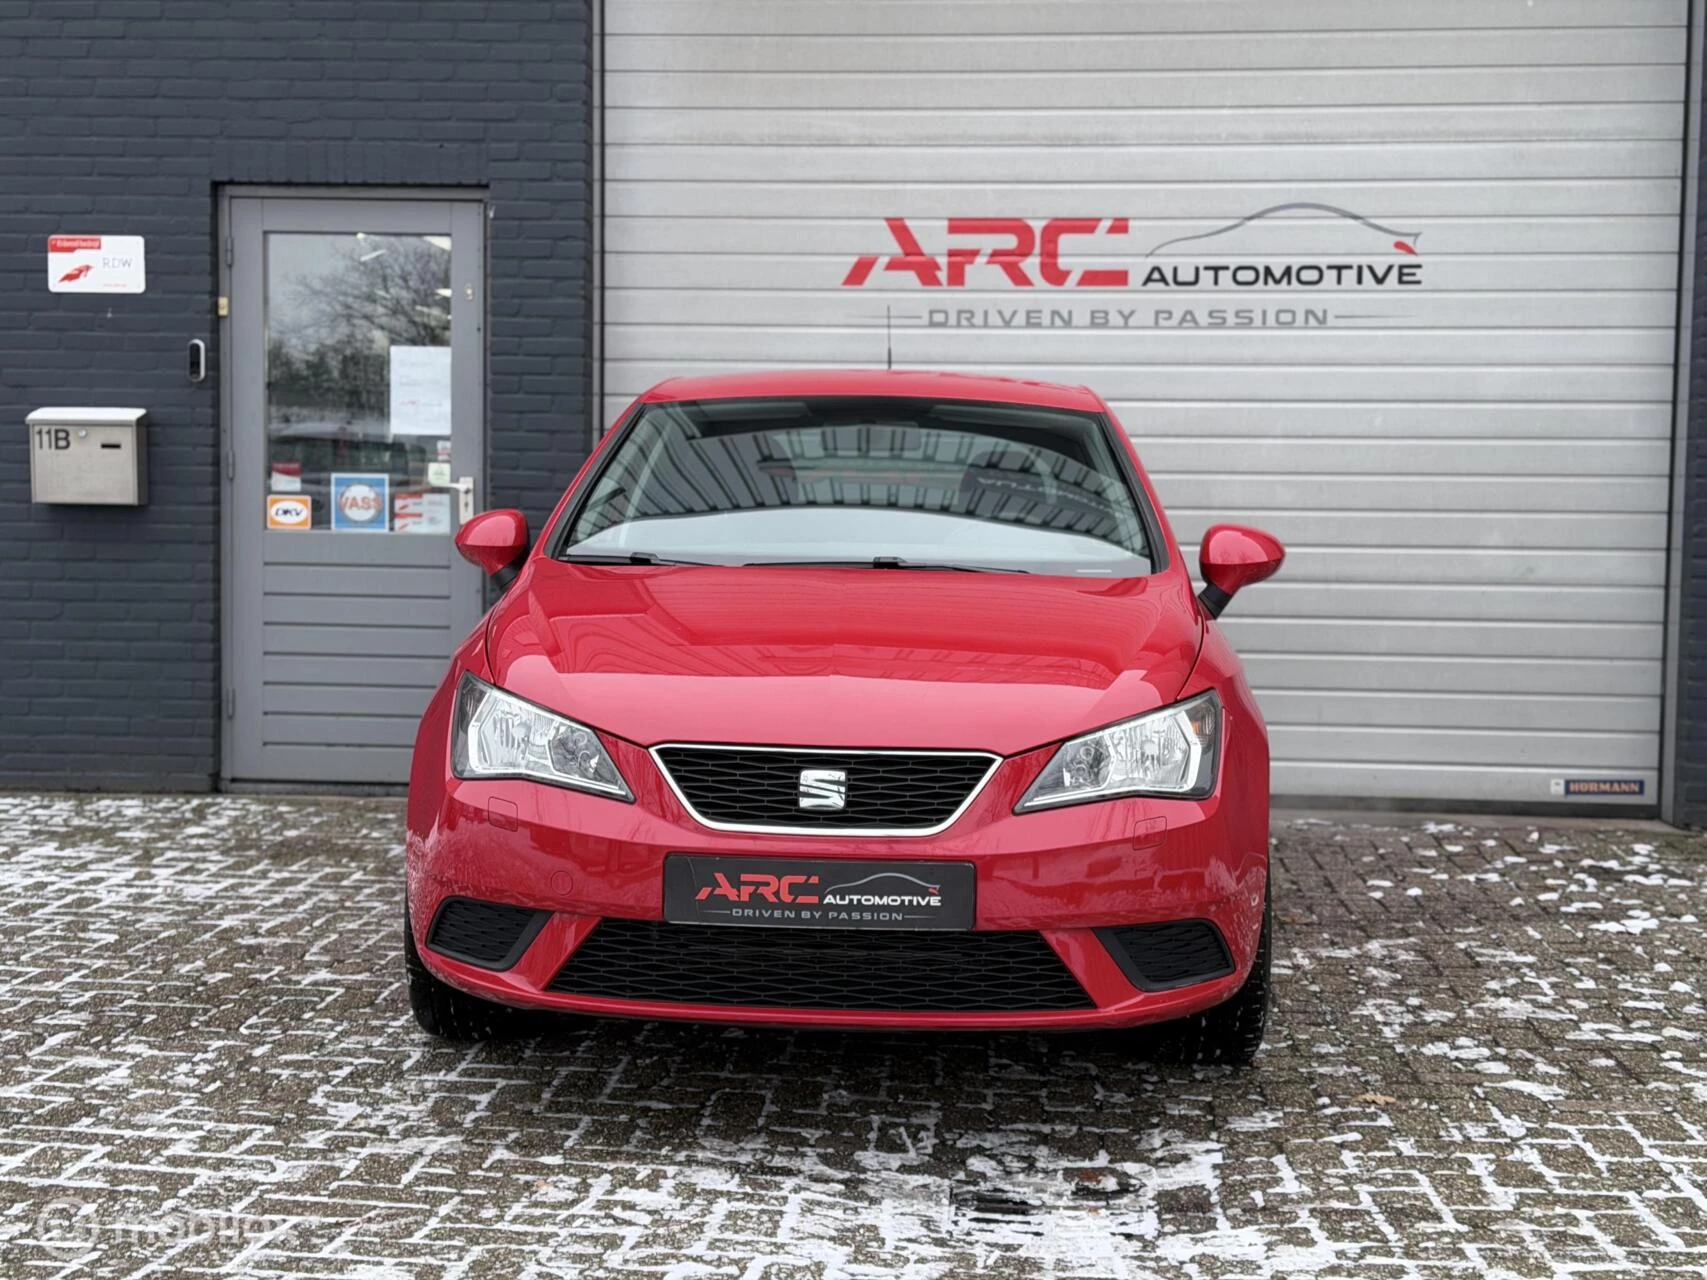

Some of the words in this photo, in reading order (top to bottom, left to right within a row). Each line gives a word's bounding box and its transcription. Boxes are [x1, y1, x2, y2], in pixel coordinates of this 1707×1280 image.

[102, 257, 133, 268] RDW
[842, 218, 1129, 287] ARC
[1142, 264, 1422, 287] AUTOMOTIVE
[928, 309, 1073, 327] DRIVEN
[1090, 309, 1137, 327] BY
[1154, 309, 1329, 327] PASSION
[36, 428, 71, 450] 11B
[695, 872, 819, 903] ARC
[823, 894, 942, 906] AUTOMOTIVE
[732, 908, 797, 918] DRIVEN
[801, 909, 823, 919] BY
[828, 911, 903, 921] PASSION
